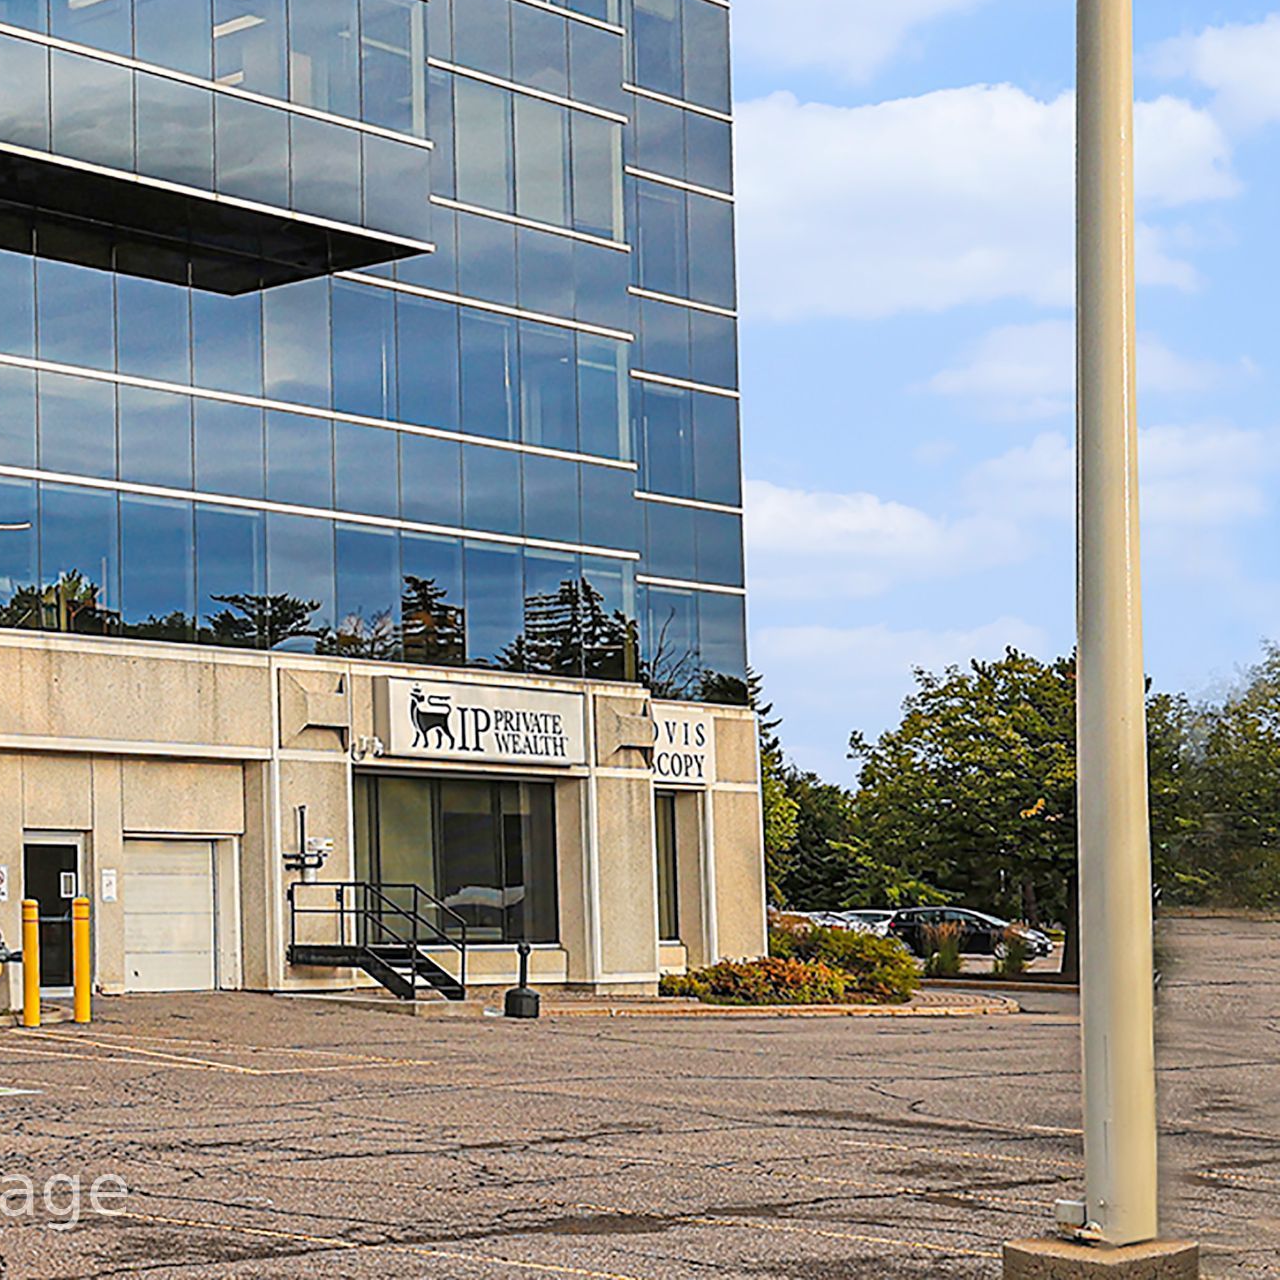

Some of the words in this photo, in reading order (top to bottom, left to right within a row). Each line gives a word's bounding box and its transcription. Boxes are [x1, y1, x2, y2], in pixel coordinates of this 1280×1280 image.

[456, 706, 491, 752] IP
[493, 709, 562, 735] PRIVATE
[494, 732, 567, 757] WEALTH
